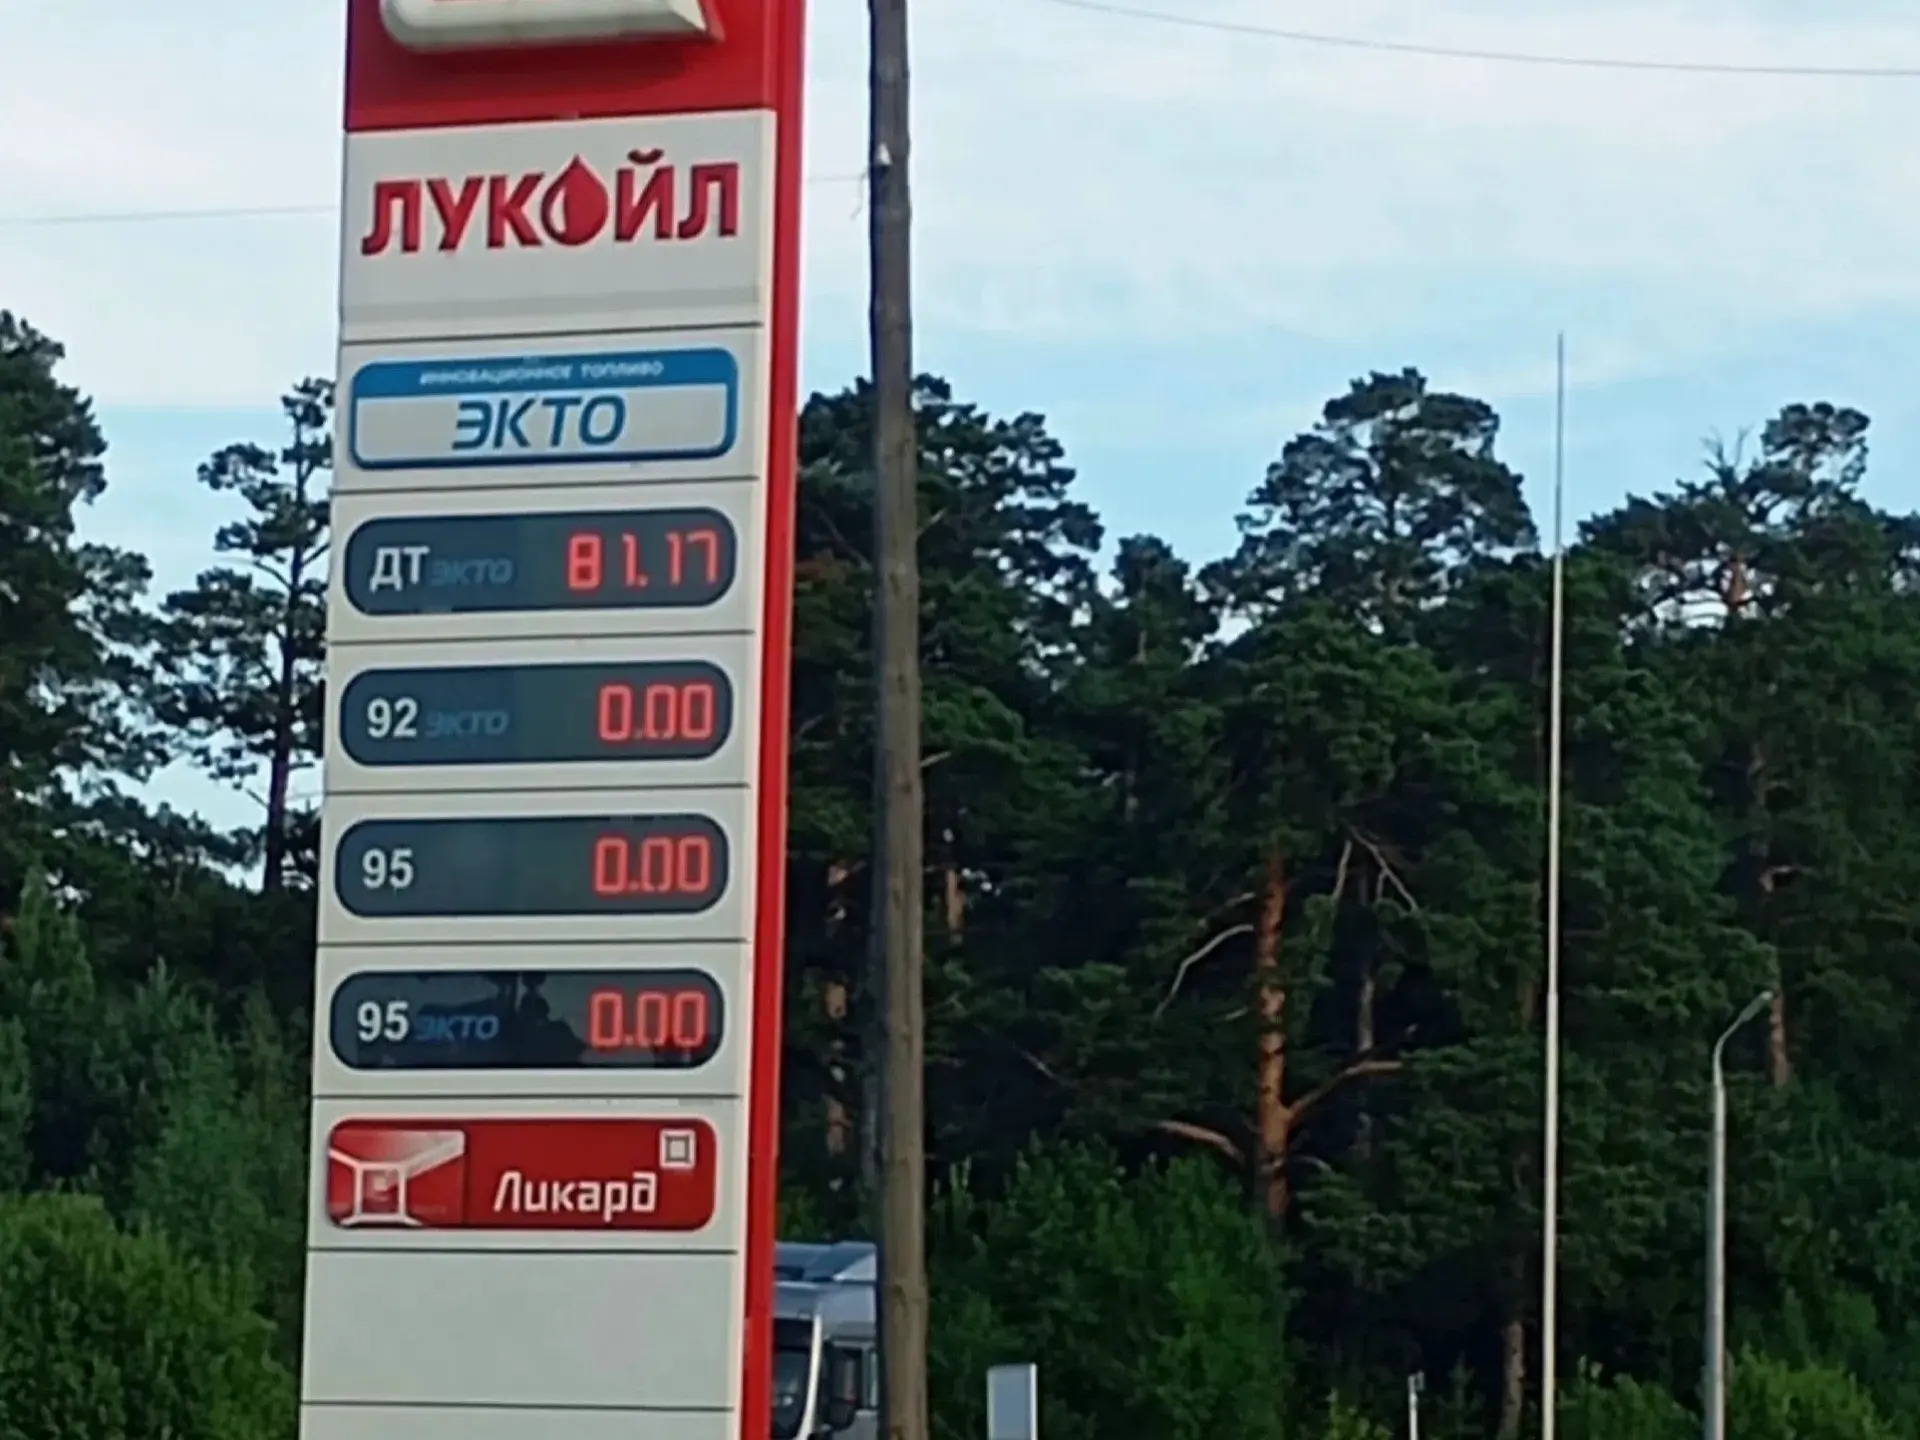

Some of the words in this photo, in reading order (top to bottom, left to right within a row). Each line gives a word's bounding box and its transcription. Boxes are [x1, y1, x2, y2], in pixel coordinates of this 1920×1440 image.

[453, 393, 626, 451] ЭКТО
[369, 546, 429, 592] ДТ
[430, 553, 514, 587] ЭКТО
[567, 529, 720, 590] 81.17
[367, 698, 418, 738] 92
[425, 709, 510, 738] ЭКТО
[599, 683, 714, 742] 0.00
[362, 848, 415, 888] 95
[593, 836, 710, 893] 0.00
[356, 1001, 410, 1042] 95
[412, 1013, 500, 1040] ЭКТО
[588, 991, 707, 1048] 0.00
[494, 1171, 658, 1222] Ликард
